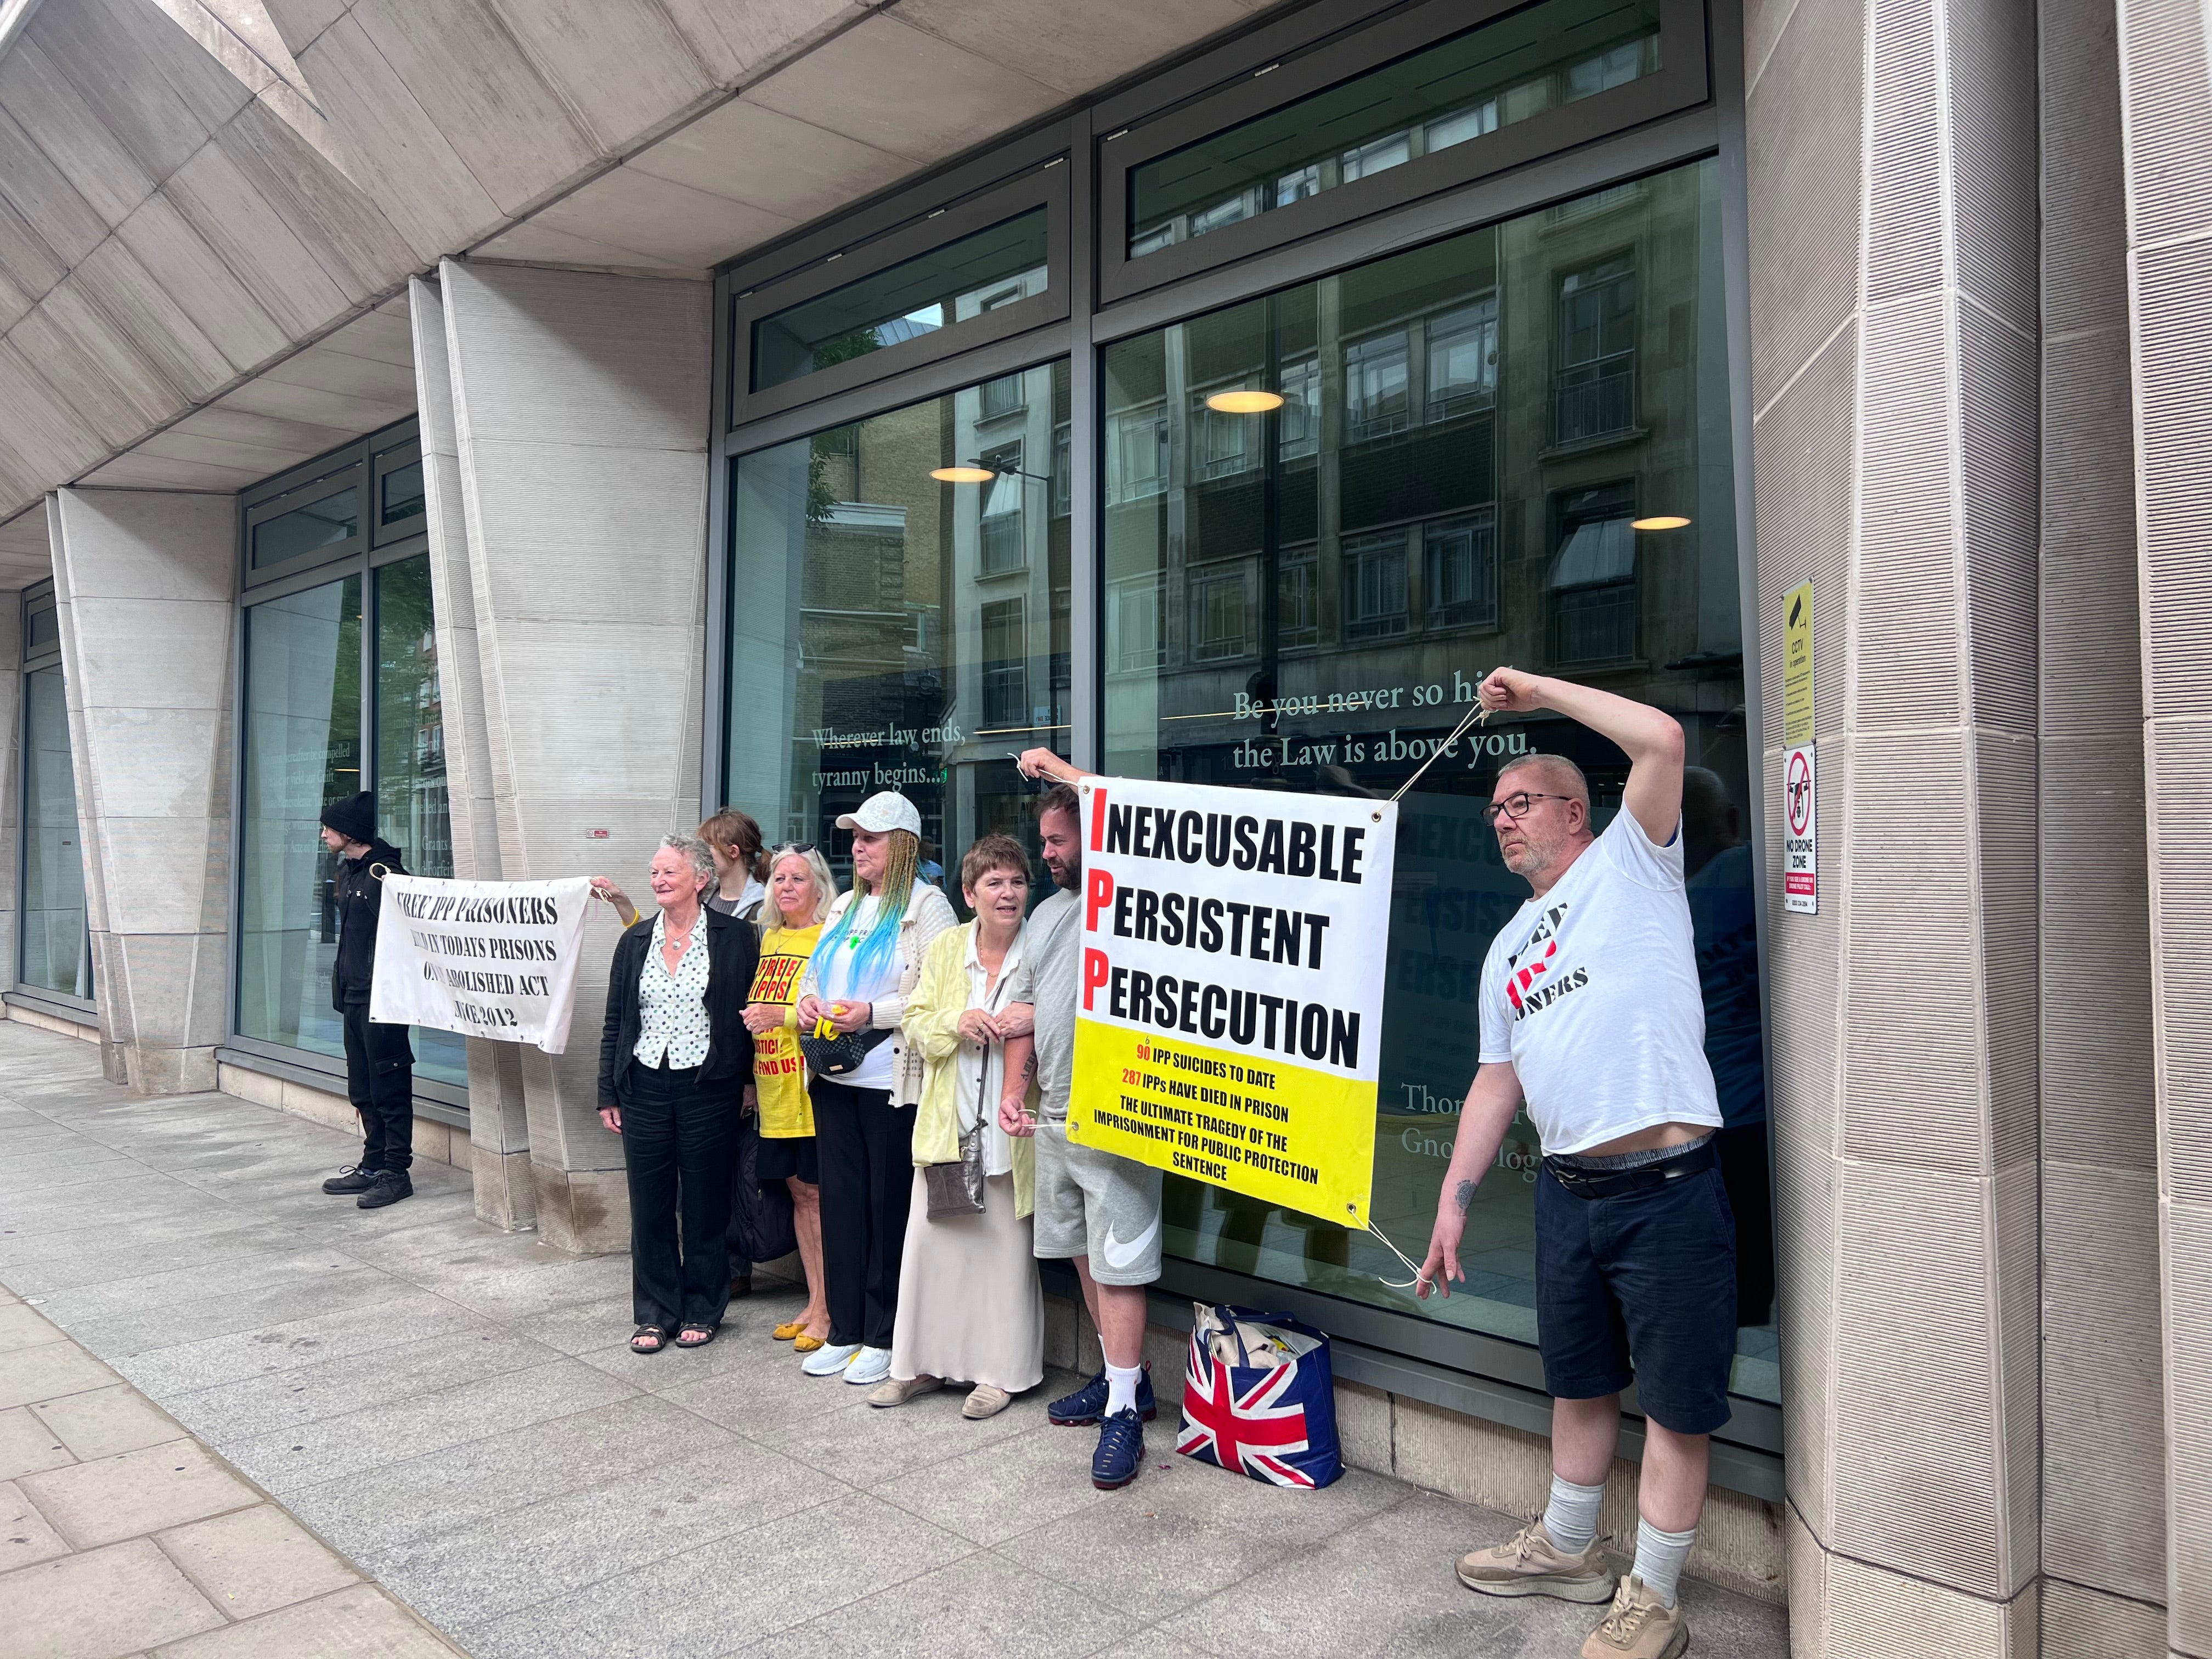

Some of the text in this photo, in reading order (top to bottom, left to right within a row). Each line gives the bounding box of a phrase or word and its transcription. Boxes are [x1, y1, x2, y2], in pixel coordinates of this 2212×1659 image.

[1792, 638, 1803, 654] CCTV
[1233, 692, 1263, 720] Be
[1271, 695, 1319, 729] you
[1327, 687, 1404, 713] never
[1412, 684, 1443, 707] so
[812, 718, 966, 749] Wherever law ends,
[1233, 738, 1272, 769] the
[1280, 738, 1338, 766] Law
[1344, 735, 1364, 764] is
[1373, 729, 1458, 762] above
[812, 762, 940, 795] tyranny begins...
[1090, 788, 1365, 884] INEXCUSABLE
[1786, 839, 1813, 852] NO DRONE
[1792, 855, 1806, 868] ZONE
[428, 896, 456, 921] IPP
[455, 896, 558, 925] PRISONERS
[1086, 868, 1330, 970] PERSISTENT
[440, 935, 486, 958] TODAYS
[489, 938, 557, 961] PRISONS
[445, 968, 514, 995] ABOLISHED
[520, 975, 550, 996] ACT
[758, 959, 798, 977] FREE
[749, 981, 787, 1000] IPPS
[481, 1006, 518, 1027] 2012
[1083, 947, 1361, 1069] PERSECUTION
[1137, 1044, 1276, 1090] 90 IPP SUICIDES TO DATE
[1122, 1068, 1289, 1123] 287 IPPs HAVE DIED IN PRISON
[1120, 1095, 1288, 1153] THE ULTIMATE TRAGEDY OF THE
[1094, 1109, 1319, 1186] IMPRISONMENT FOR PUBLIC PROTECTION
[1173, 1152, 1227, 1182] SENTENCE
